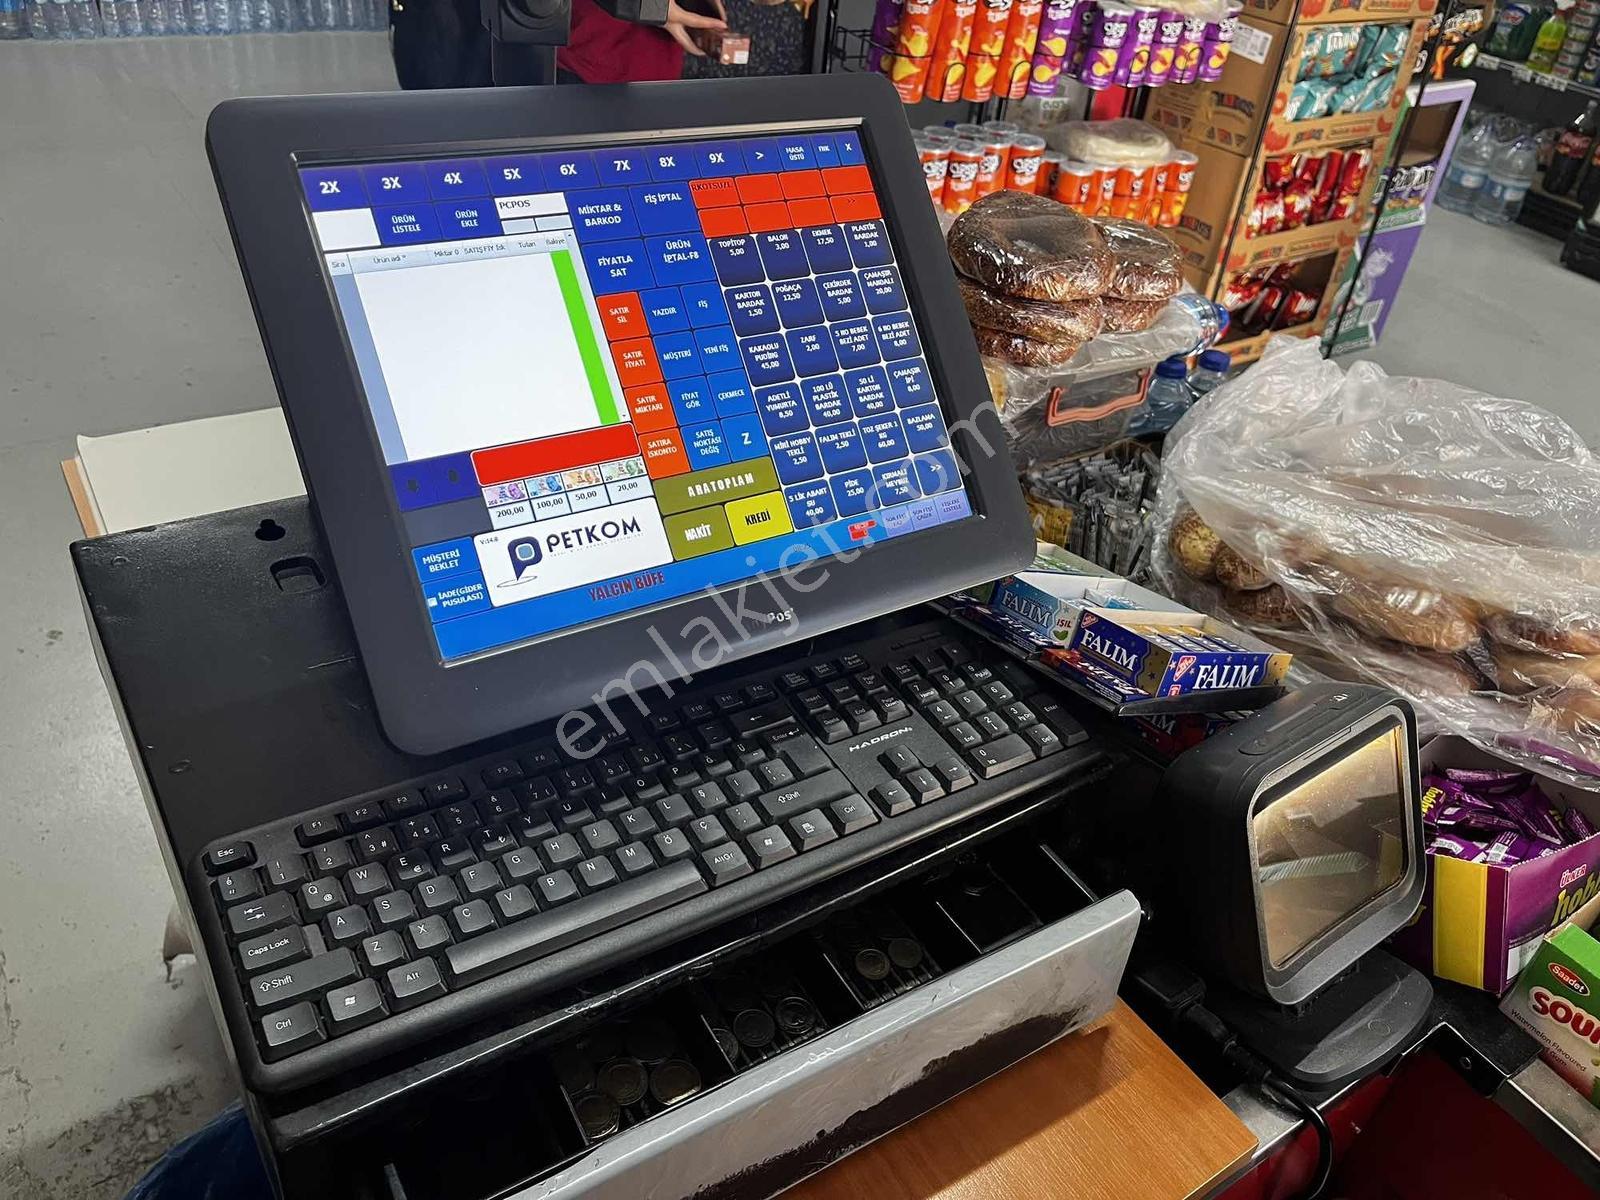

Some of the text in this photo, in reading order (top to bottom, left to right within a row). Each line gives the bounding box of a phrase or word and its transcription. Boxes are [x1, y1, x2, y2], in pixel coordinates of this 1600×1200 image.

[659, 156, 675, 167] 8X
[709, 152, 724, 164] 9X
[559, 164, 577, 175] 6X
[614, 159, 630, 171] 7X
[443, 172, 463, 185] 4X
[503, 168, 522, 180] 5X
[320, 181, 340, 194] 2X
[381, 177, 402, 189] 3X
[644, 191, 682, 206] FİŞ İPTAL
[499, 200, 531, 210] PCPOS
[578, 202, 622, 215] MİKTAR &
[392, 214, 416, 224] ÜRÜN
[455, 209, 478, 219] ÜRÜN
[461, 218, 479, 228] EKLE
[585, 215, 621, 227] BARKOD
[392, 223, 421, 234] LİSTELE
[851, 222, 876, 232] PLASTİK
[854, 231, 879, 240] BARDAK
[665, 239, 691, 250] ÜRÜN
[718, 239, 745, 249] TOPİTOP
[775, 242, 790, 251] 3,00
[817, 237, 834, 246] 17,50
[663, 250, 700, 263] İPTAL-F8
[729, 248, 744, 256] 5,00
[597, 255, 633, 267] FİYATLA
[610, 267, 627, 278] SAT
[863, 269, 892, 280] ÇAMAŞIR
[822, 279, 852, 290] ÇEKİRDEK
[866, 278, 894, 288] MANDALI
[775, 284, 801, 294] POĞAÇA
[827, 288, 853, 298] BARDAK
[875, 286, 892, 296] 20,00
[734, 291, 761, 301] KARTON
[783, 292, 801, 302] 12,50
[837, 296, 851, 305] 5,00
[698, 300, 708, 310] FİŞ
[737, 300, 765, 309] BARDAK
[609, 306, 629, 316] SATIR
[652, 307, 677, 317] YAZDIR
[748, 308, 762, 317] 1,50
[617, 315, 627, 324] SİL
[800, 335, 816, 344] ZARF
[853, 334, 869, 344] ADET
[895, 329, 910, 339] ADET
[703, 343, 729, 355] YENİ FİŞ
[748, 342, 779, 353] KAKAOLU
[806, 343, 820, 352] 2,00
[851, 344, 865, 352] 7,00
[623, 350, 643, 360] SATIR
[663, 349, 692, 361] MÜŞTERİ
[755, 351, 779, 362] PUDİNG
[625, 358, 646, 369] FİYATI
[761, 361, 780, 370] 45,00
[893, 367, 921, 378] ÇAMAŞIR
[859, 377, 867, 385] 50
[718, 388, 745, 400] ÇEKMECE
[812, 384, 824, 393] 100
[856, 384, 881, 394] KARTON
[636, 395, 657, 404] SATIR
[681, 391, 699, 401] FİYAT
[767, 390, 791, 403] ADETLİ
[812, 391, 839, 402] PLASTİK
[859, 392, 884, 402] BARDAK
[635, 403, 663, 414] MİKTARI
[685, 399, 700, 409] GÖR
[766, 400, 797, 411] YUMURTA
[815, 400, 842, 410] BARDAK
[866, 401, 884, 410] 40,00
[823, 408, 840, 418] 40,00
[907, 413, 936, 425] BAZLAMA
[862, 422, 892, 434] TOZ ŞEKER
[916, 422, 933, 431] 50,00
[695, 429, 714, 440] SATIŞ
[741, 432, 752, 445] Z
[819, 429, 856, 444] FALIM TEKLİ
[647, 438, 672, 449] SATIRA
[693, 436, 722, 448] NOKTASI
[790, 437, 811, 447] HOBBY
[835, 441, 849, 449] 2,50
[878, 439, 895, 448] 60,00
[649, 447, 677, 459] İSKONTO
[700, 445, 720, 456] DEĞİŞ
[786, 447, 805, 458] TEKLİ
[793, 456, 807, 465] 2,50
[617, 481, 638, 492] 20,00
[687, 472, 754, 498] ARATOPLAM
[844, 478, 860, 488] PİDE
[575, 491, 597, 501] 50,00
[846, 486, 865, 497] 25,00
[895, 486, 908, 495] 7,50
[536, 498, 563, 510] 100,00
[496, 506, 525, 518] 200,00
[745, 508, 771, 526] KREDİ
[546, 516, 642, 553] PETKOM
[684, 523, 712, 541] NAKİT
[422, 549, 461, 565] MÜŞTERİ
[429, 559, 459, 573] BEKLET
[635, 571, 665, 589] BÜFE
[1002, 590, 1052, 627] FALIM
[1081, 630, 1138, 671] FALIM
[1192, 665, 1258, 689] FALIM
[849, 727, 911, 752] HADRON
[217, 848, 234, 858] Esc
[714, 851, 734, 864] AltGr
[248, 937, 290, 957] Caps Lock
[271, 974, 293, 988] Shift
[405, 970, 419, 982] Alt
[1552, 965, 1585, 994] Saadet
[275, 1018, 292, 1030] Ctrl
[1511, 1008, 1587, 1072] Watermelon Flavoured
